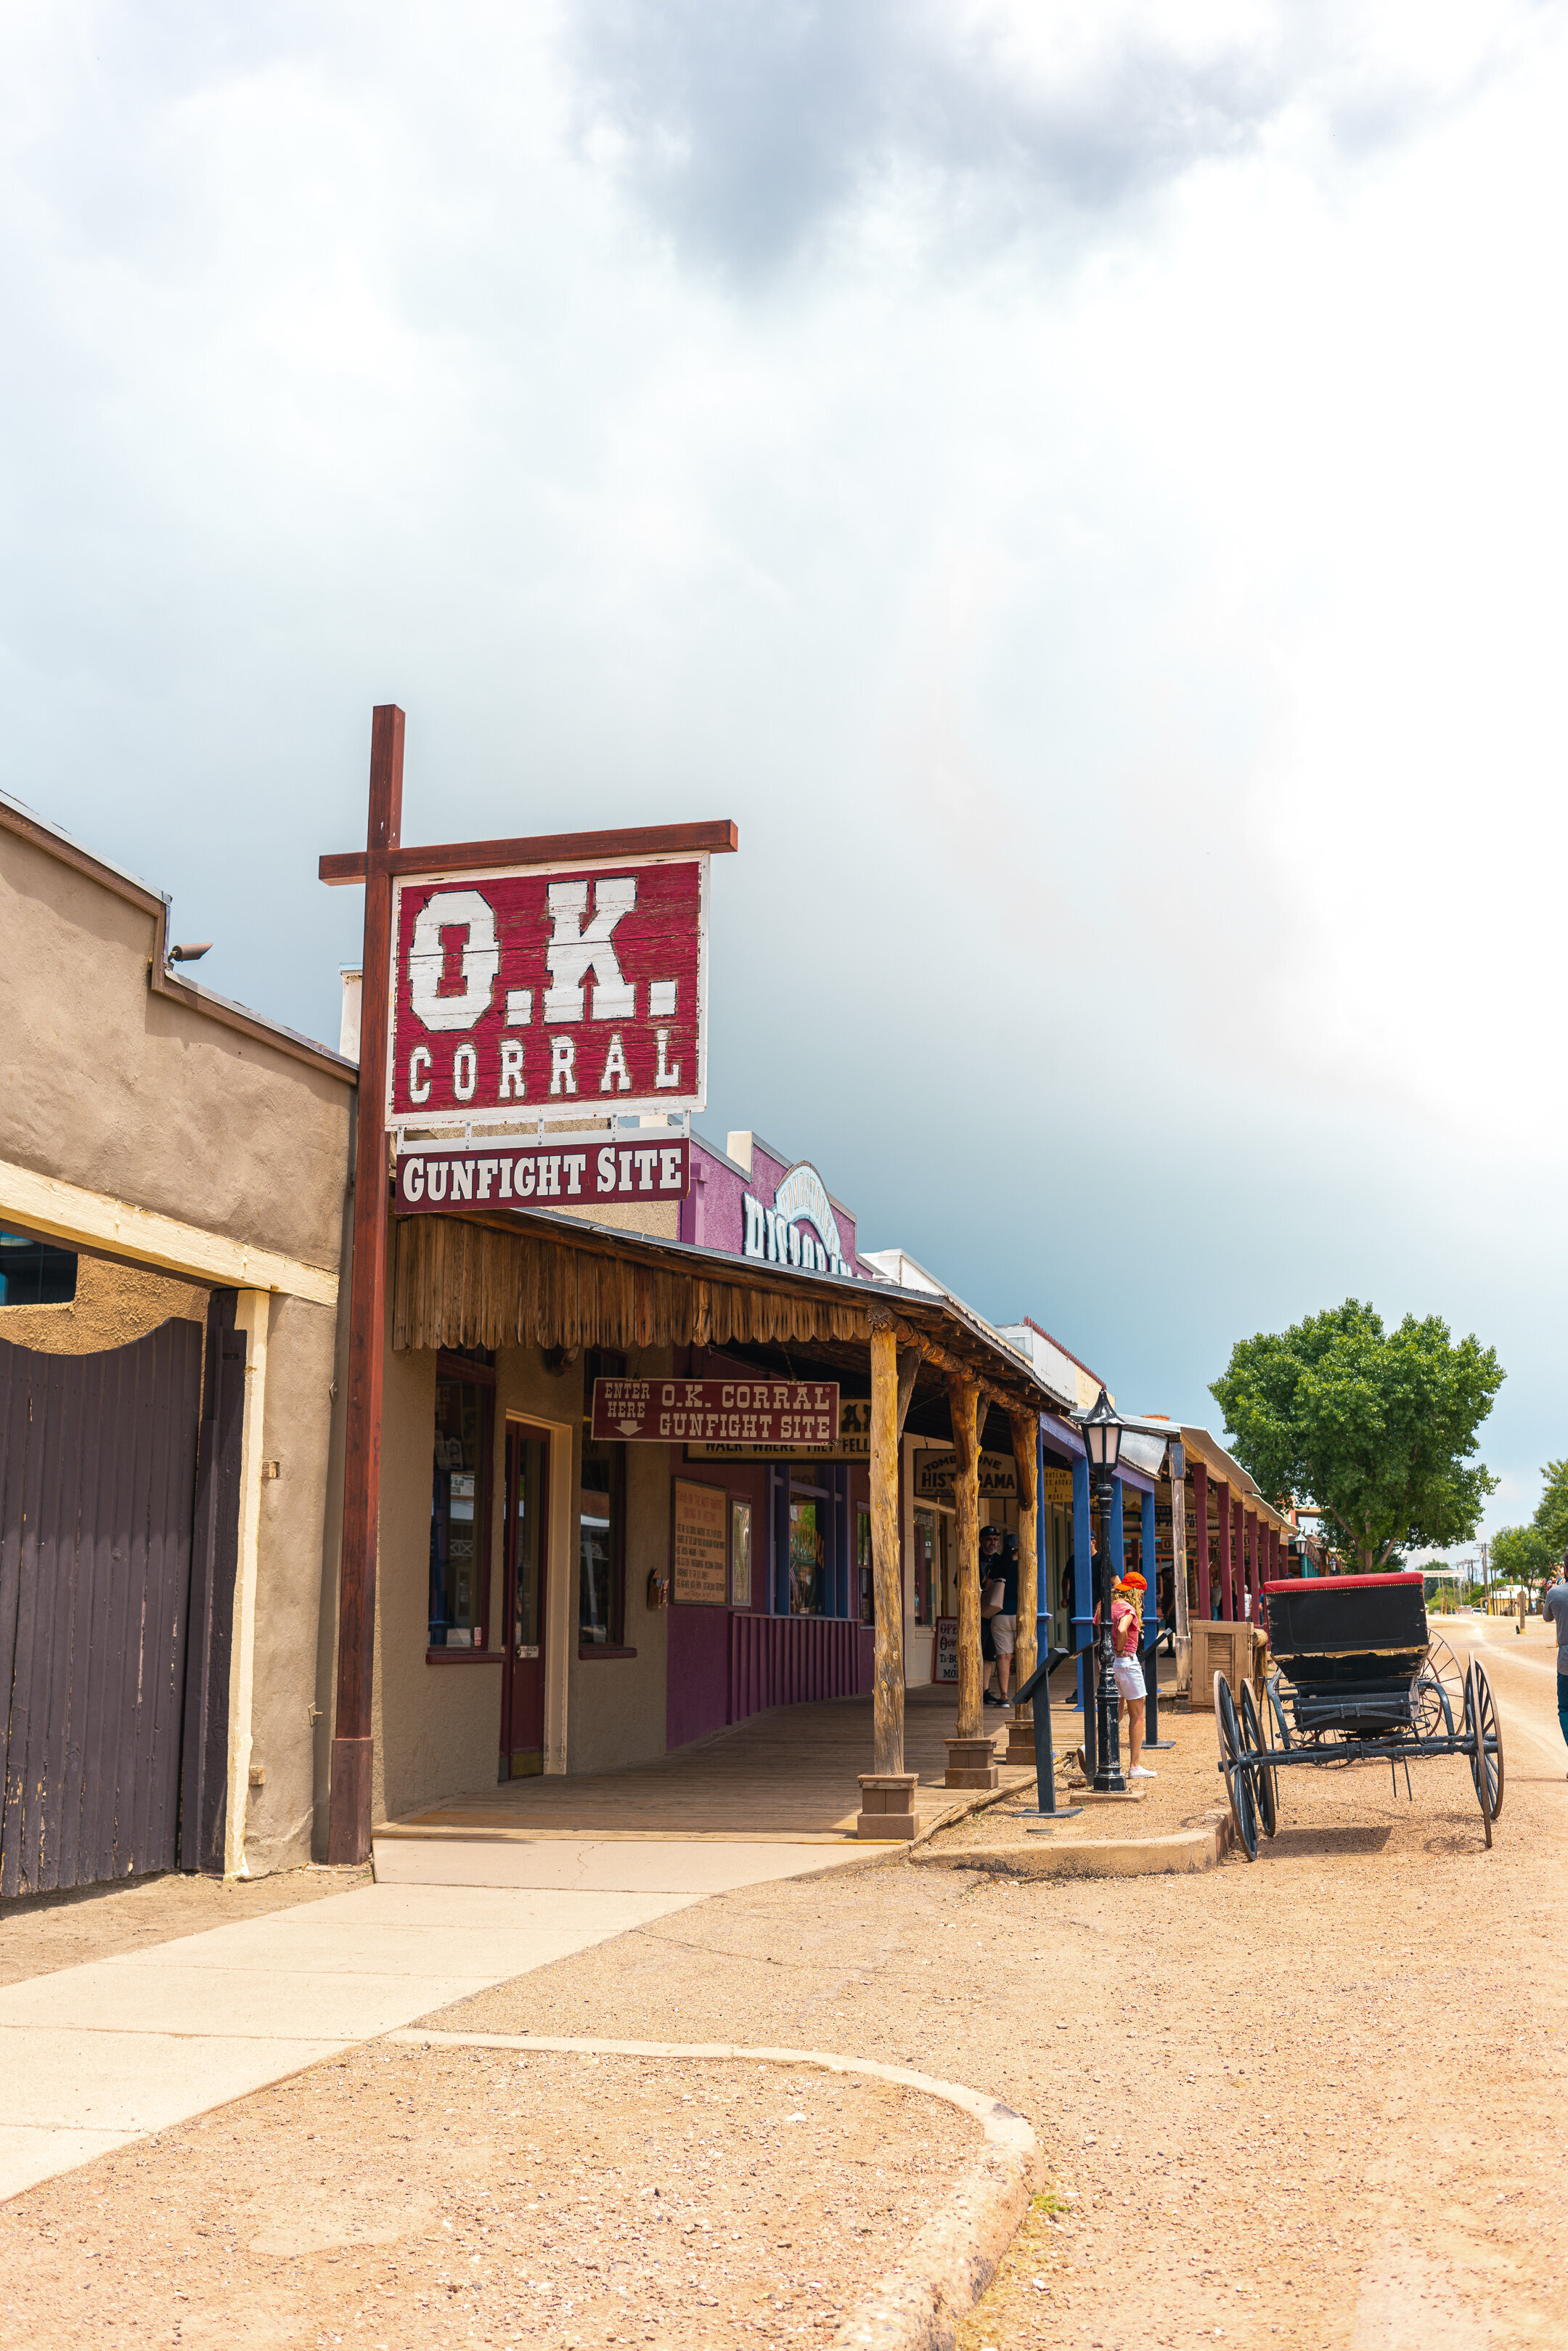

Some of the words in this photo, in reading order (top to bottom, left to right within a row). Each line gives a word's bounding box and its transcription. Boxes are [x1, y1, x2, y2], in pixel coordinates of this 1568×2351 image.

[407, 875, 677, 1032] O.K.
[408, 1028, 680, 1104] CORRAL
[402, 1154, 587, 1202] GUNFIGHT
[596, 1146, 682, 1193] SITE
[605, 1382, 650, 1399] ENTER
[662, 1384, 712, 1407] O.K.
[722, 1385, 830, 1410] CORRAL
[607, 1401, 645, 1418] HERE
[660, 1412, 772, 1438] GUNFIGHT
[780, 1416, 830, 1439] SITE
[843, 1438, 870, 1452] FELL
[923, 1455, 1002, 1472] TOMBONE
[921, 1472, 1015, 1488] HISTRAMA
[940, 1623, 957, 1634] OPE
